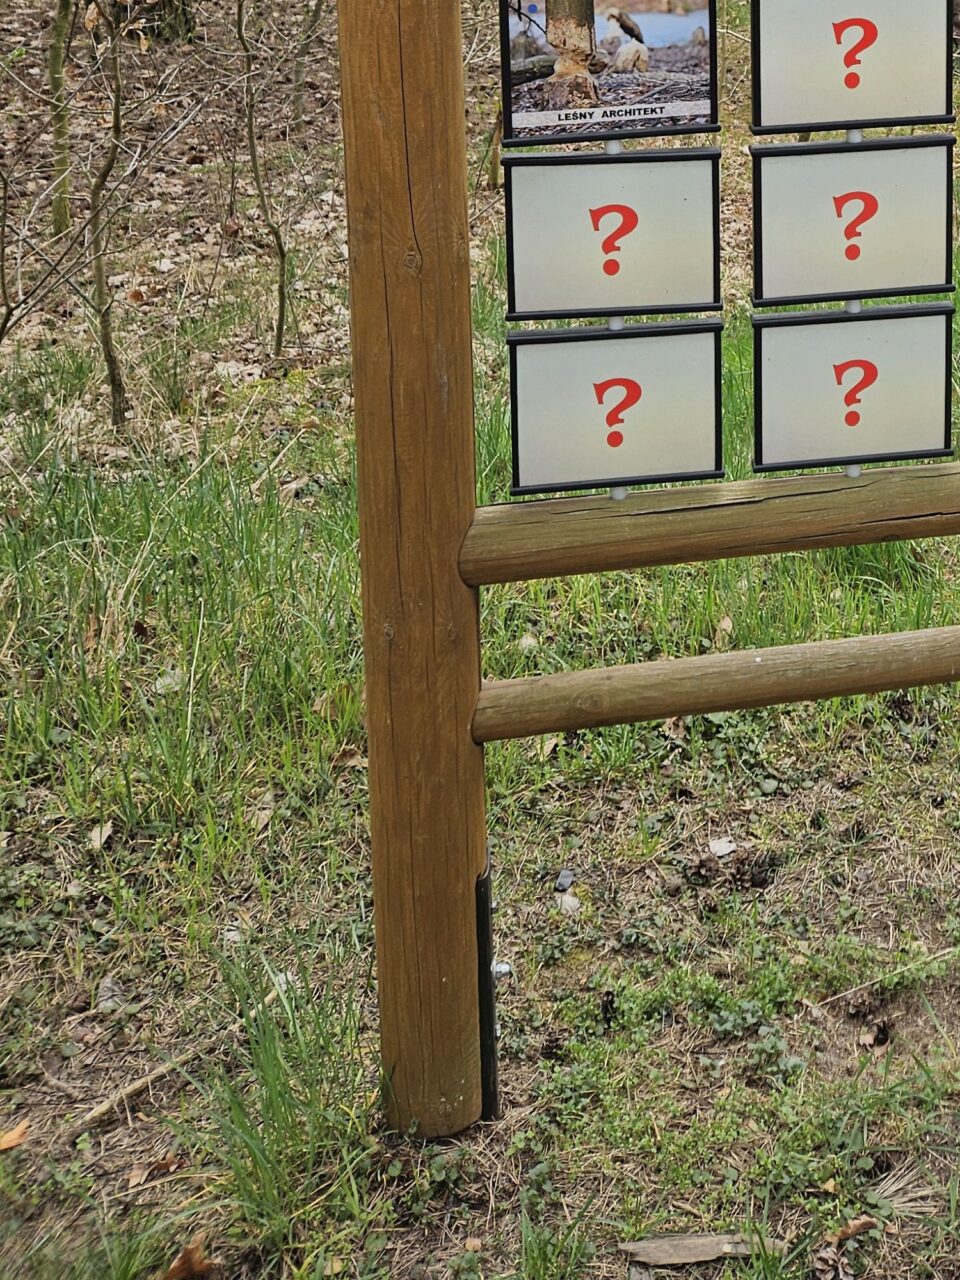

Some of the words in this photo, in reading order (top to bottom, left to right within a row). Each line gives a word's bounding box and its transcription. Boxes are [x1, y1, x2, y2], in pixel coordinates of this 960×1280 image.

[834, 19, 877, 88] ?
[557, 111, 595, 122] LEŚNY
[601, 106, 666, 119] ARCHITEKT
[591, 205, 637, 275] ?
[835, 193, 877, 259] ?
[595, 379, 641, 446] ?
[835, 360, 877, 425] ?
